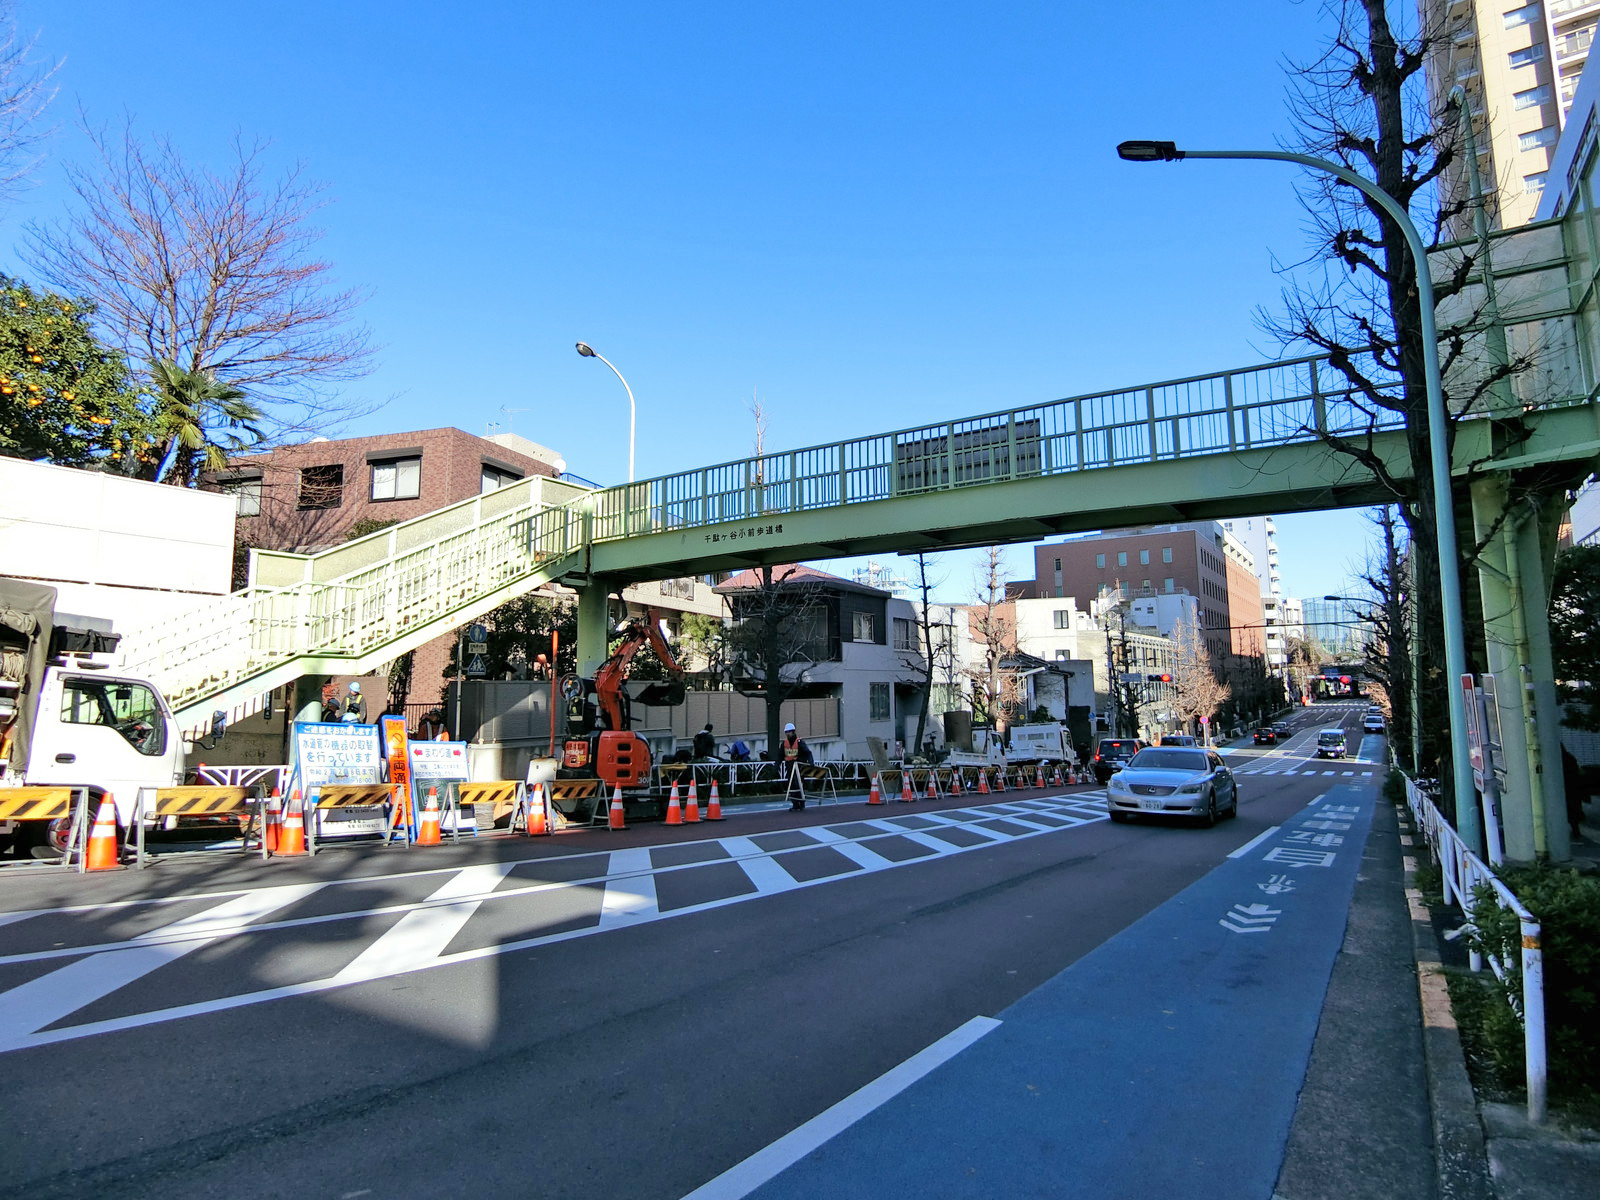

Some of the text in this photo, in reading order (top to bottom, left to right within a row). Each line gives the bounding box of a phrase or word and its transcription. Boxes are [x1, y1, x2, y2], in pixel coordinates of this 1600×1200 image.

[303, 725, 371, 736] ご迷惑をおかします
[306, 751, 372, 763] を行っています
